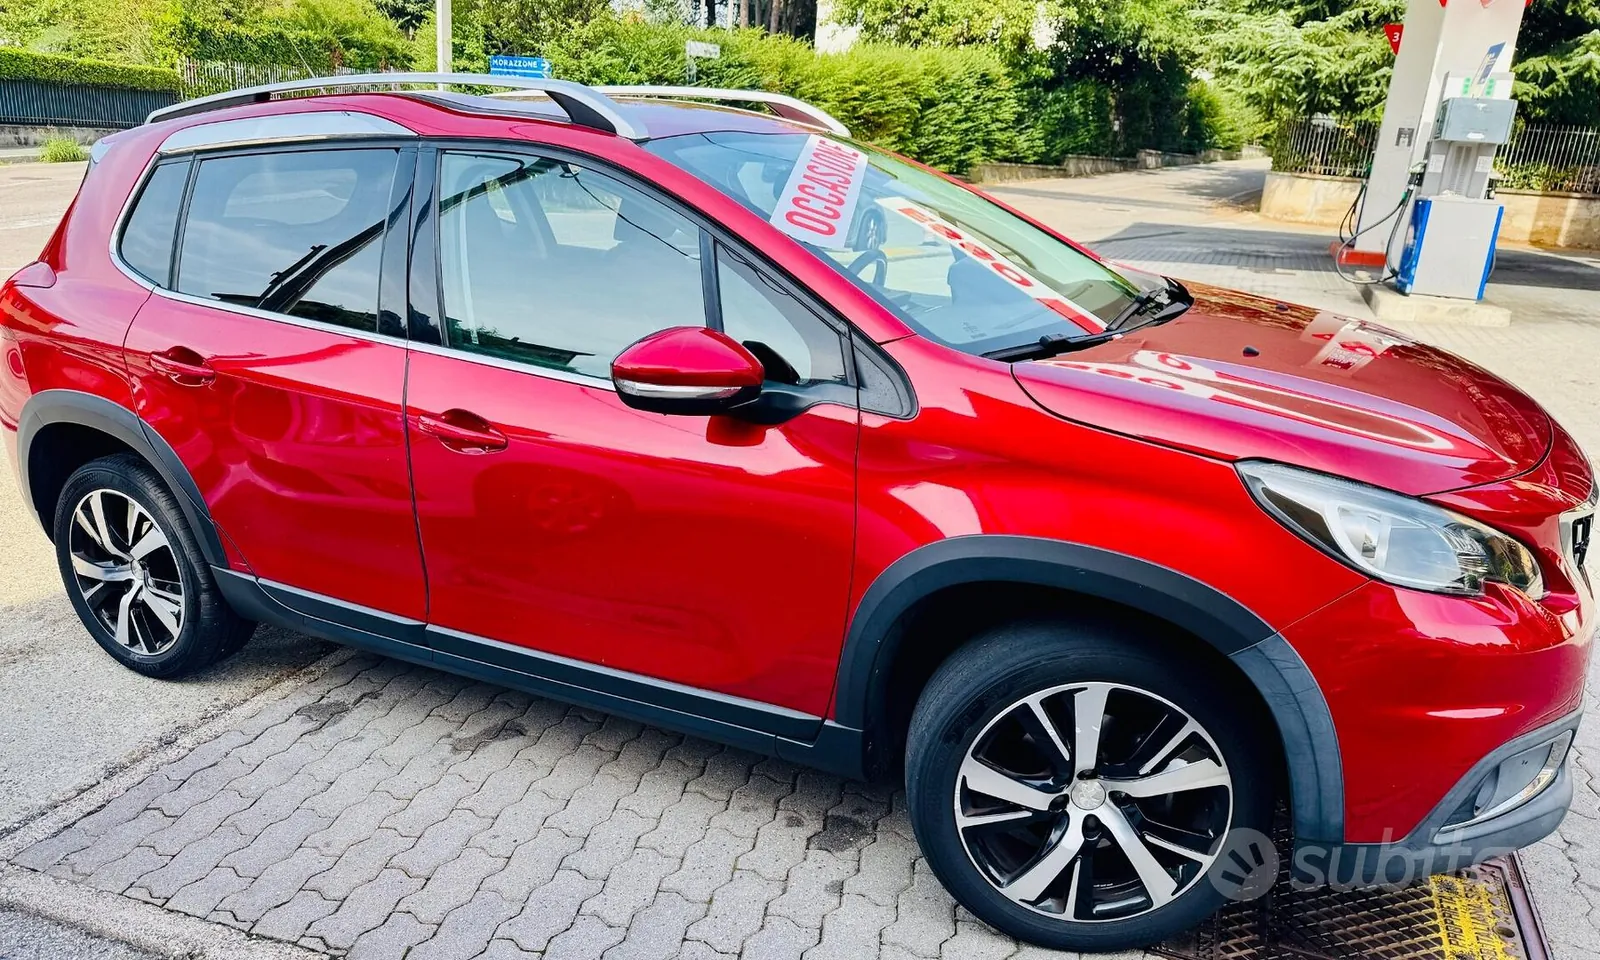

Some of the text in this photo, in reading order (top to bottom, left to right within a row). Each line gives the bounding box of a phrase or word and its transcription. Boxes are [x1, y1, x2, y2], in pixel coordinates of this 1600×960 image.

[1392, 32, 1401, 43] 3
[492, 58, 538, 68] MORAZZONE
[784, 139, 860, 237] OCCASIONE
